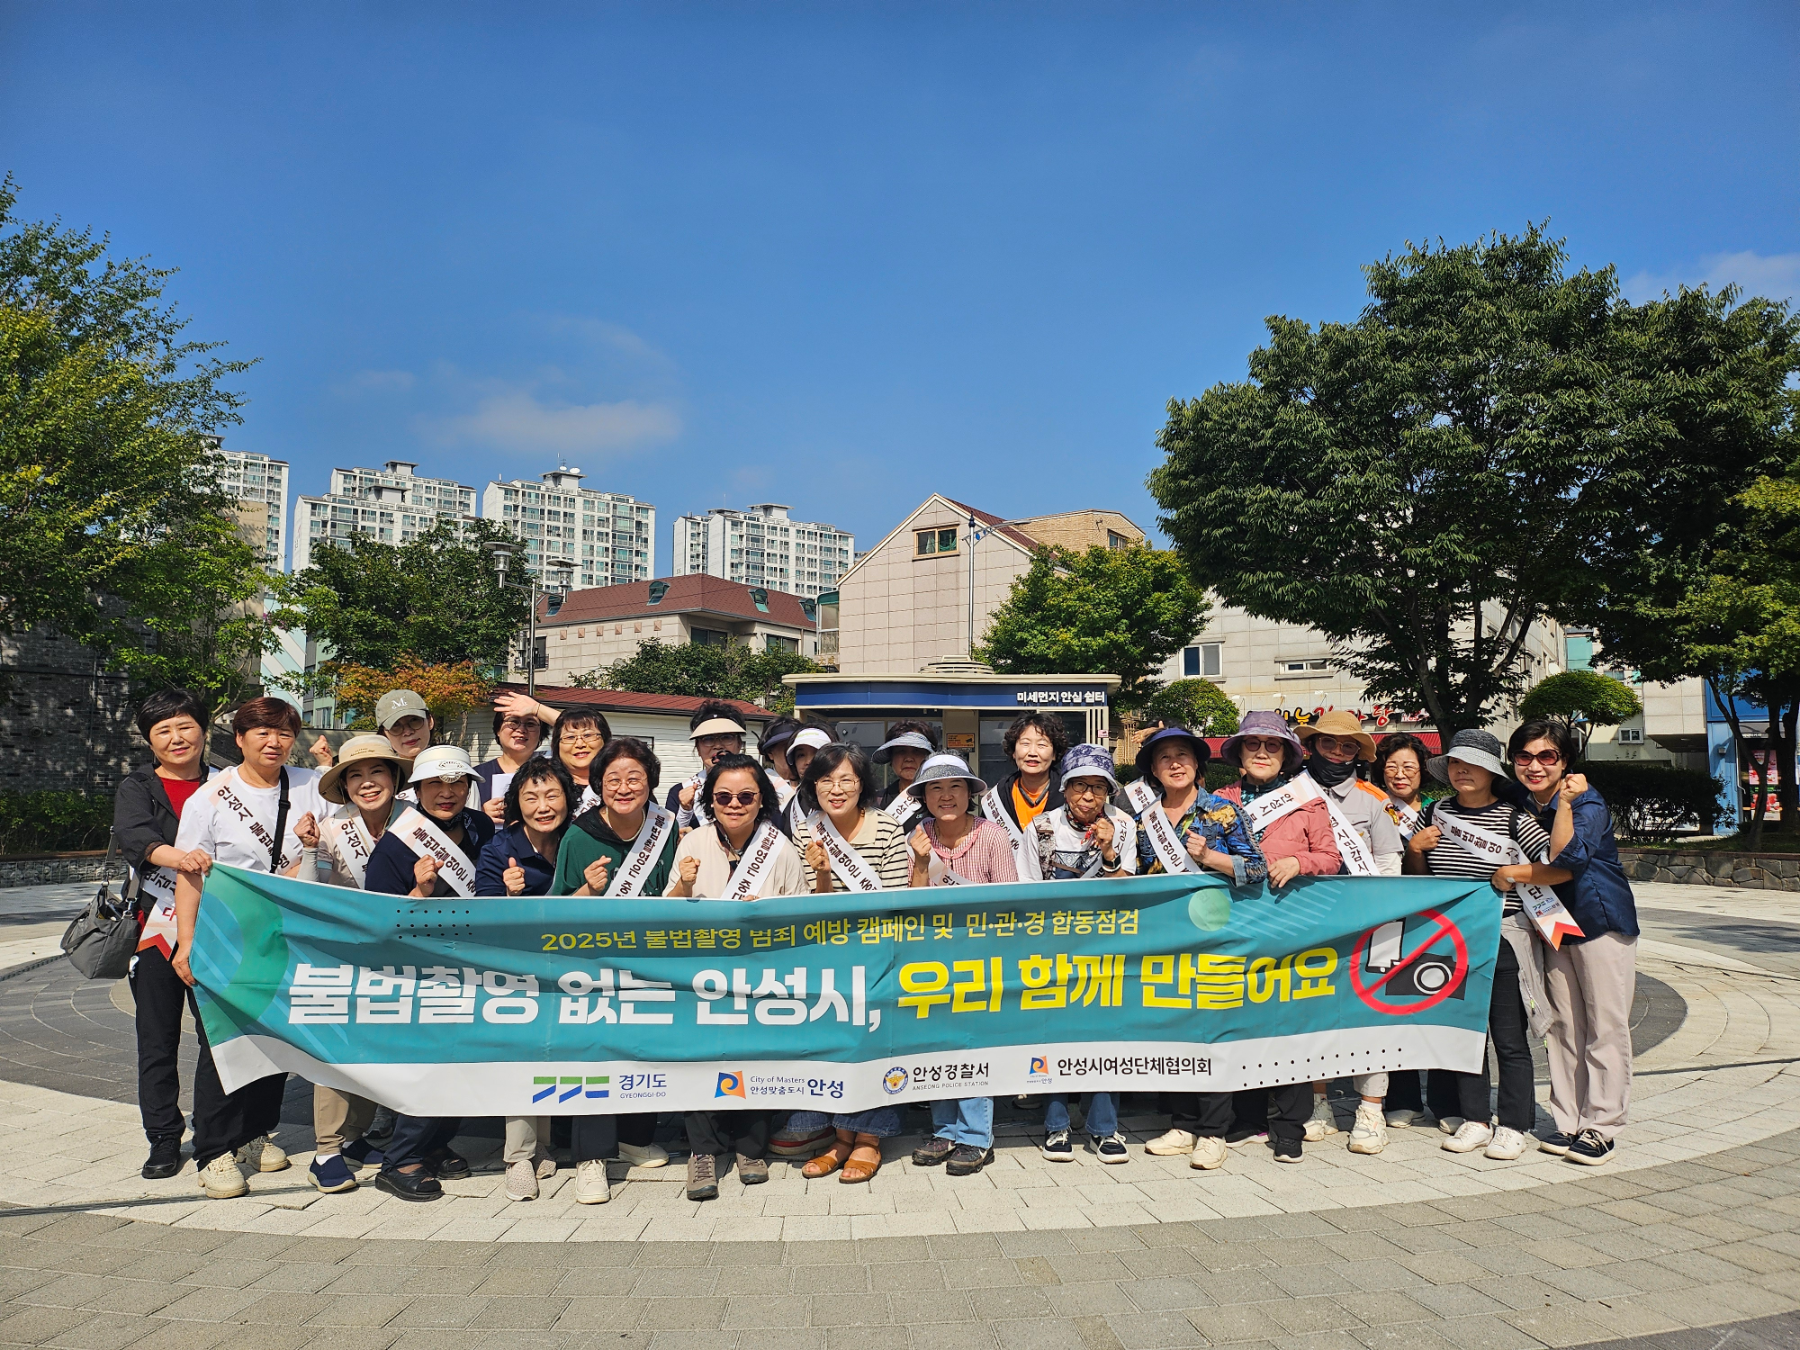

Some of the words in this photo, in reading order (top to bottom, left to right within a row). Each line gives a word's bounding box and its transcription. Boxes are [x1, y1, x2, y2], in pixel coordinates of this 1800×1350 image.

[1016, 691, 1060, 703] 미세먼지
[1083, 691, 1106, 703] 쉼터
[1260, 793, 1295, 816] 안성시
[217, 786, 254, 822] 안성시
[249, 821, 290, 869] 불법영
[341, 819, 370, 861] 안성시
[1148, 810, 1183, 867] 불법촬영은
[1450, 825, 1503, 855] 불법촬영
[413, 826, 469, 882] 불법촬영은
[629, 814, 666, 879] 불법촬영은
[746, 824, 779, 878] 법촬영은
[816, 821, 862, 879] 불법촬영은
[1337, 828, 1373, 877] 시민감시
[540, 930, 637, 951] 2025년
[643, 928, 741, 949] 불법촬영
[749, 924, 796, 948] 범죄
[803, 918, 851, 946] 예방
[857, 914, 925, 944] 캠페인
[932, 912, 953, 940] 및
[1052, 908, 1139, 936] 합동점검
[288, 963, 540, 1025] 불법촬영
[557, 967, 676, 1025] 없는
[691, 965, 882, 1033] 안성시,
[897, 956, 1004, 1019] 우리
[1018, 953, 1126, 1011] 함께
[1140, 947, 1338, 1010] 만들어요
[618, 1073, 668, 1091] 경기도
[750, 1076, 765, 1084] City
[776, 1076, 805, 1084] Masters
[912, 1062, 989, 1083] 안성경찰서
[1057, 1056, 1212, 1076] 안성시여성단체협의회
[750, 1086, 805, 1095] 안성맞춤도시
[807, 1078, 844, 1099] 안성
[912, 1083, 940, 1091] ANSEONG
[942, 1081, 962, 1089] POLICE
